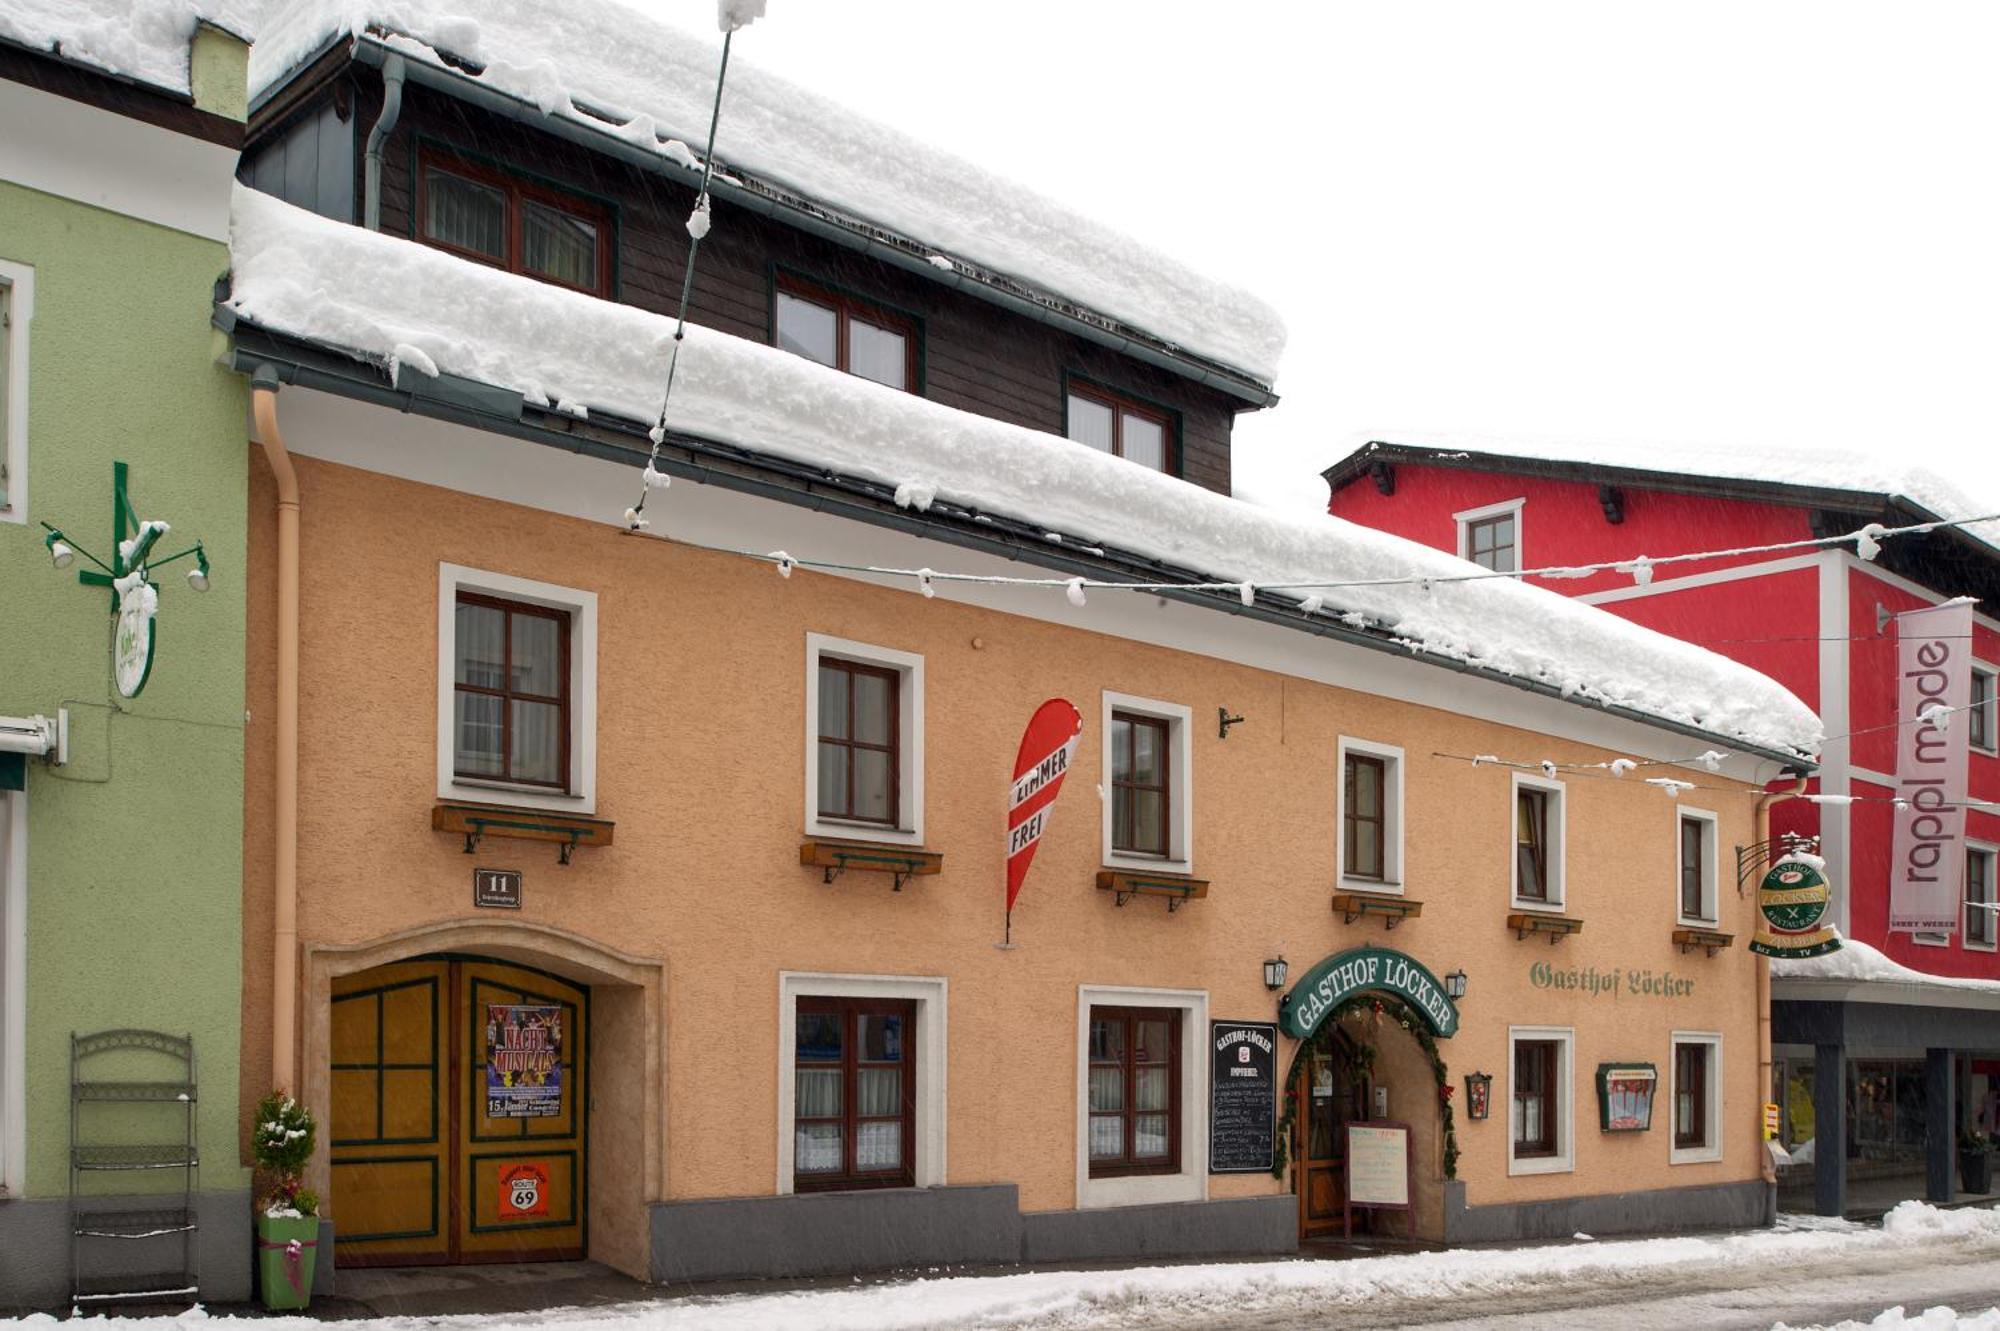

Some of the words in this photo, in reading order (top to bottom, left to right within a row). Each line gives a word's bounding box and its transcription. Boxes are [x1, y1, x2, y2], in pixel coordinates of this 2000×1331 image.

[1905, 641, 1949, 763] mode
[1017, 748, 1067, 802] ZIMMER
[1011, 813, 1042, 853] FREI
[1902, 779, 1956, 882] rappl
[489, 875, 511, 892] 11
[1770, 863, 1813, 880] GASTHOF
[1800, 948, 1811, 957] TV
[1297, 957, 1379, 1031] GASTHOF
[1384, 958, 1450, 1032] LÖCKER
[1529, 961, 1620, 999] Gasthof
[1628, 969, 1694, 997] Löcker
[504, 1027, 547, 1049] NACHT
[495, 1050, 555, 1074] MUSICALS
[515, 1191, 534, 1205] 69
